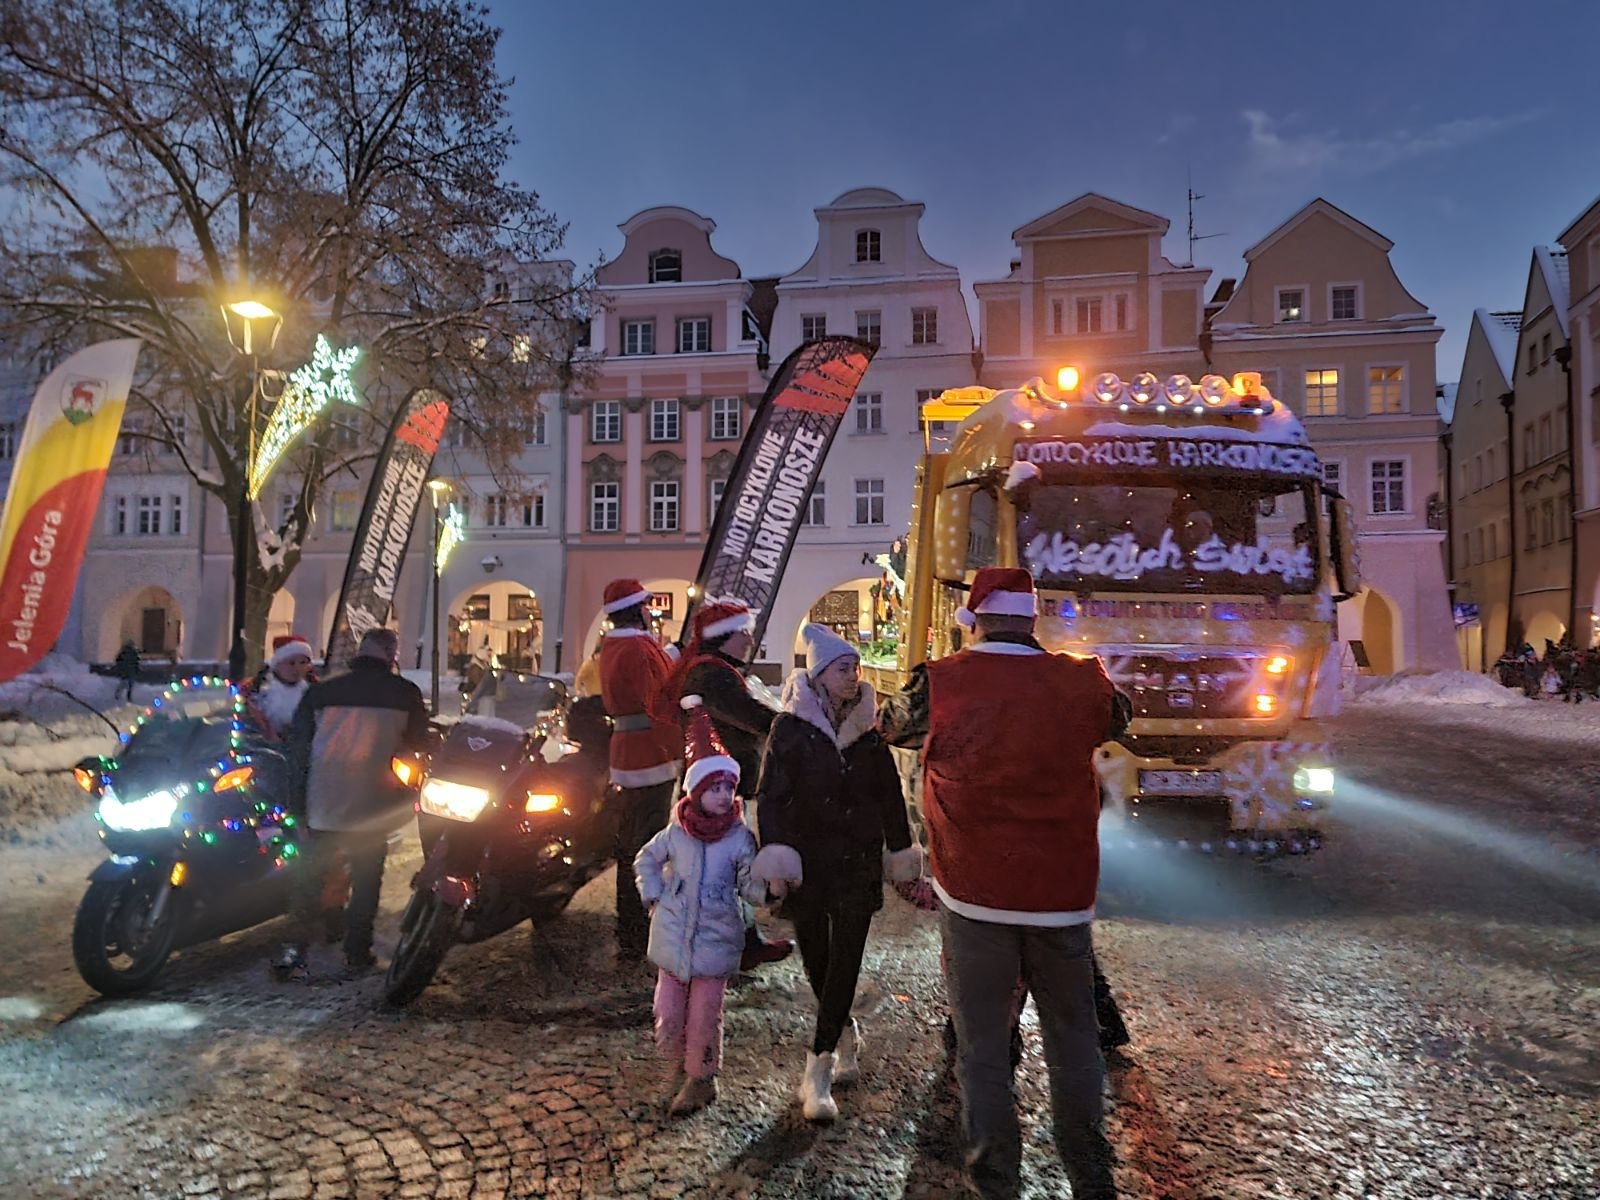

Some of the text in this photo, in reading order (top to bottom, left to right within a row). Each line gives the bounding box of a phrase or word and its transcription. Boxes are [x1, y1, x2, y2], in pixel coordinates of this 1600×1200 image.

[359, 457, 404, 574] MOTOCYKLOWE
[373, 458, 427, 600] KARKONOSZE
[722, 429, 785, 559] MOTOCYKLOWE
[743, 426, 824, 584] KARKONOSZE
[8, 510, 62, 654] Jelenia Góra
